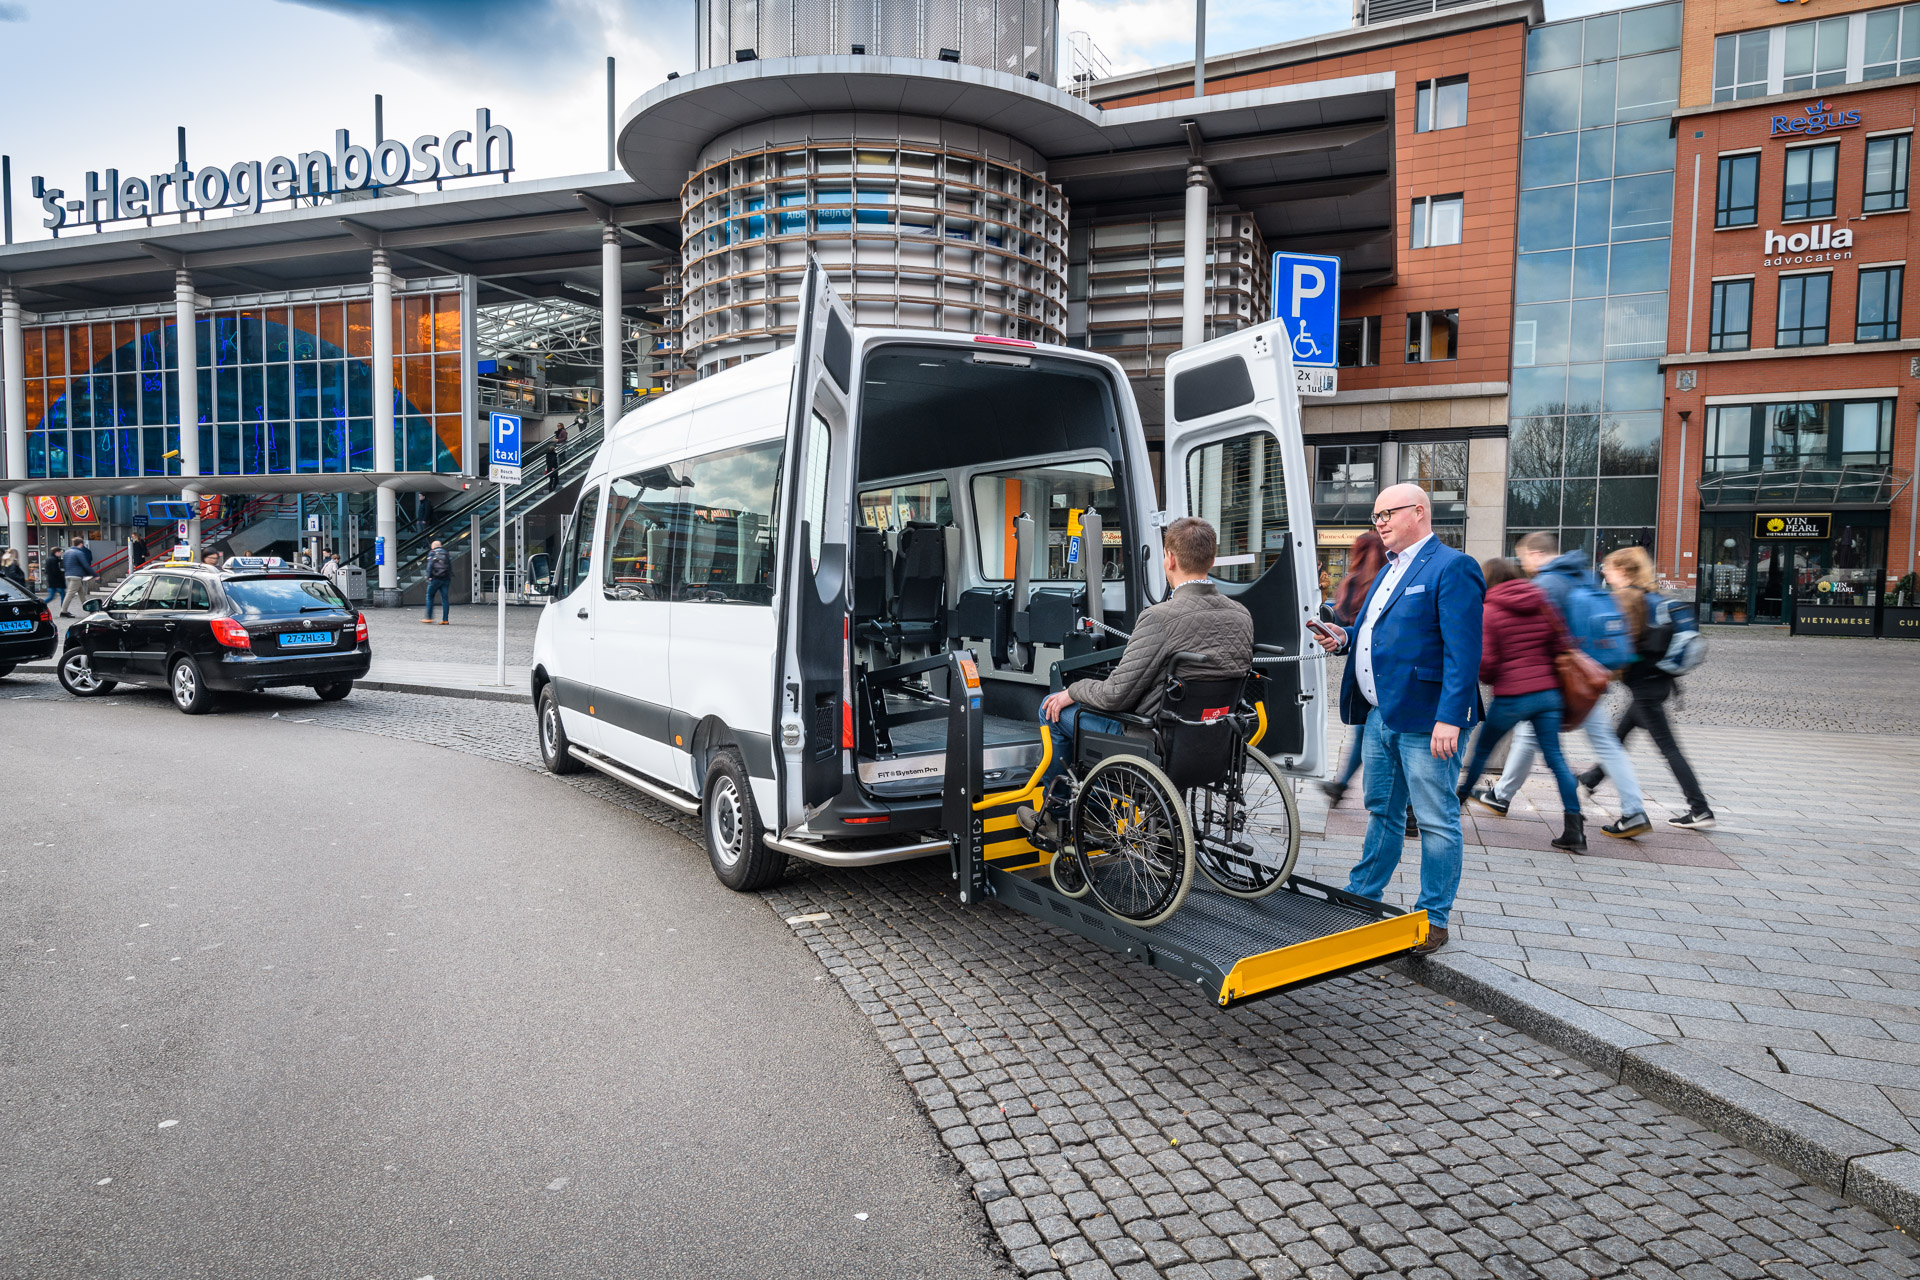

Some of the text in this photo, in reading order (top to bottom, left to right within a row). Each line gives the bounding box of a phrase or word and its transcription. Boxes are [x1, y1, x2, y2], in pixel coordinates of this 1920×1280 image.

[1770, 109, 1861, 135] Regus
[31, 107, 513, 229] 's-Hertogenbosch
[1764, 223, 1853, 255] holla
[1763, 251, 1852, 267] advocaten
[1291, 264, 1326, 318] P
[498, 418, 515, 444] P
[495, 448, 518, 461] taxi
[42, 503, 55, 514] KING
[73, 502, 87, 513] KING
[1785, 517, 1808, 525] VIN
[1785, 524, 1819, 532] PEARL
[1800, 617, 1871, 625] VIETNAMESE
[286, 633, 326, 644] 27-ZHL-3
[895, 768, 924, 777] System
